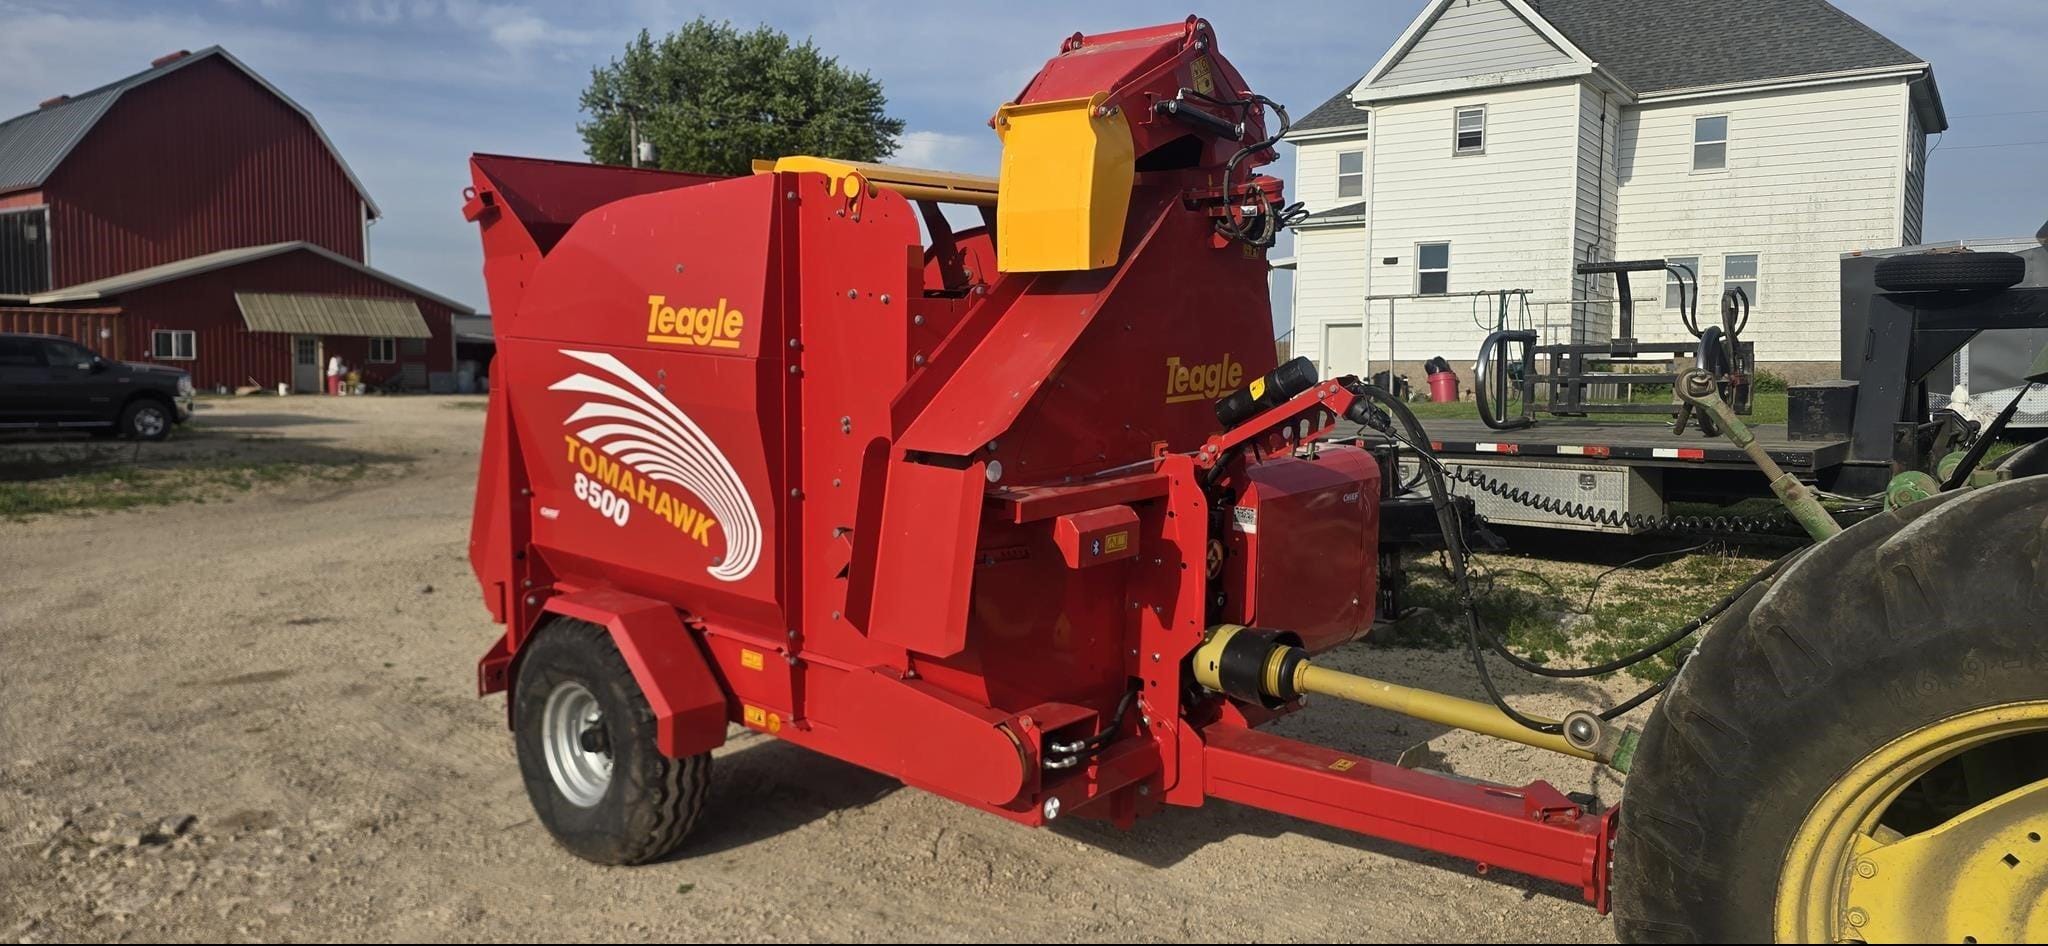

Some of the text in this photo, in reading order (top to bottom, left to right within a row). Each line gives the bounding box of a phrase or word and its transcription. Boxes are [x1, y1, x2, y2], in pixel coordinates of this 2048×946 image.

[647, 295, 743, 348] Teagle
[1166, 353, 1243, 403] Teagle
[565, 435, 716, 546] TOMAHAWK
[574, 472, 630, 527] 8500
